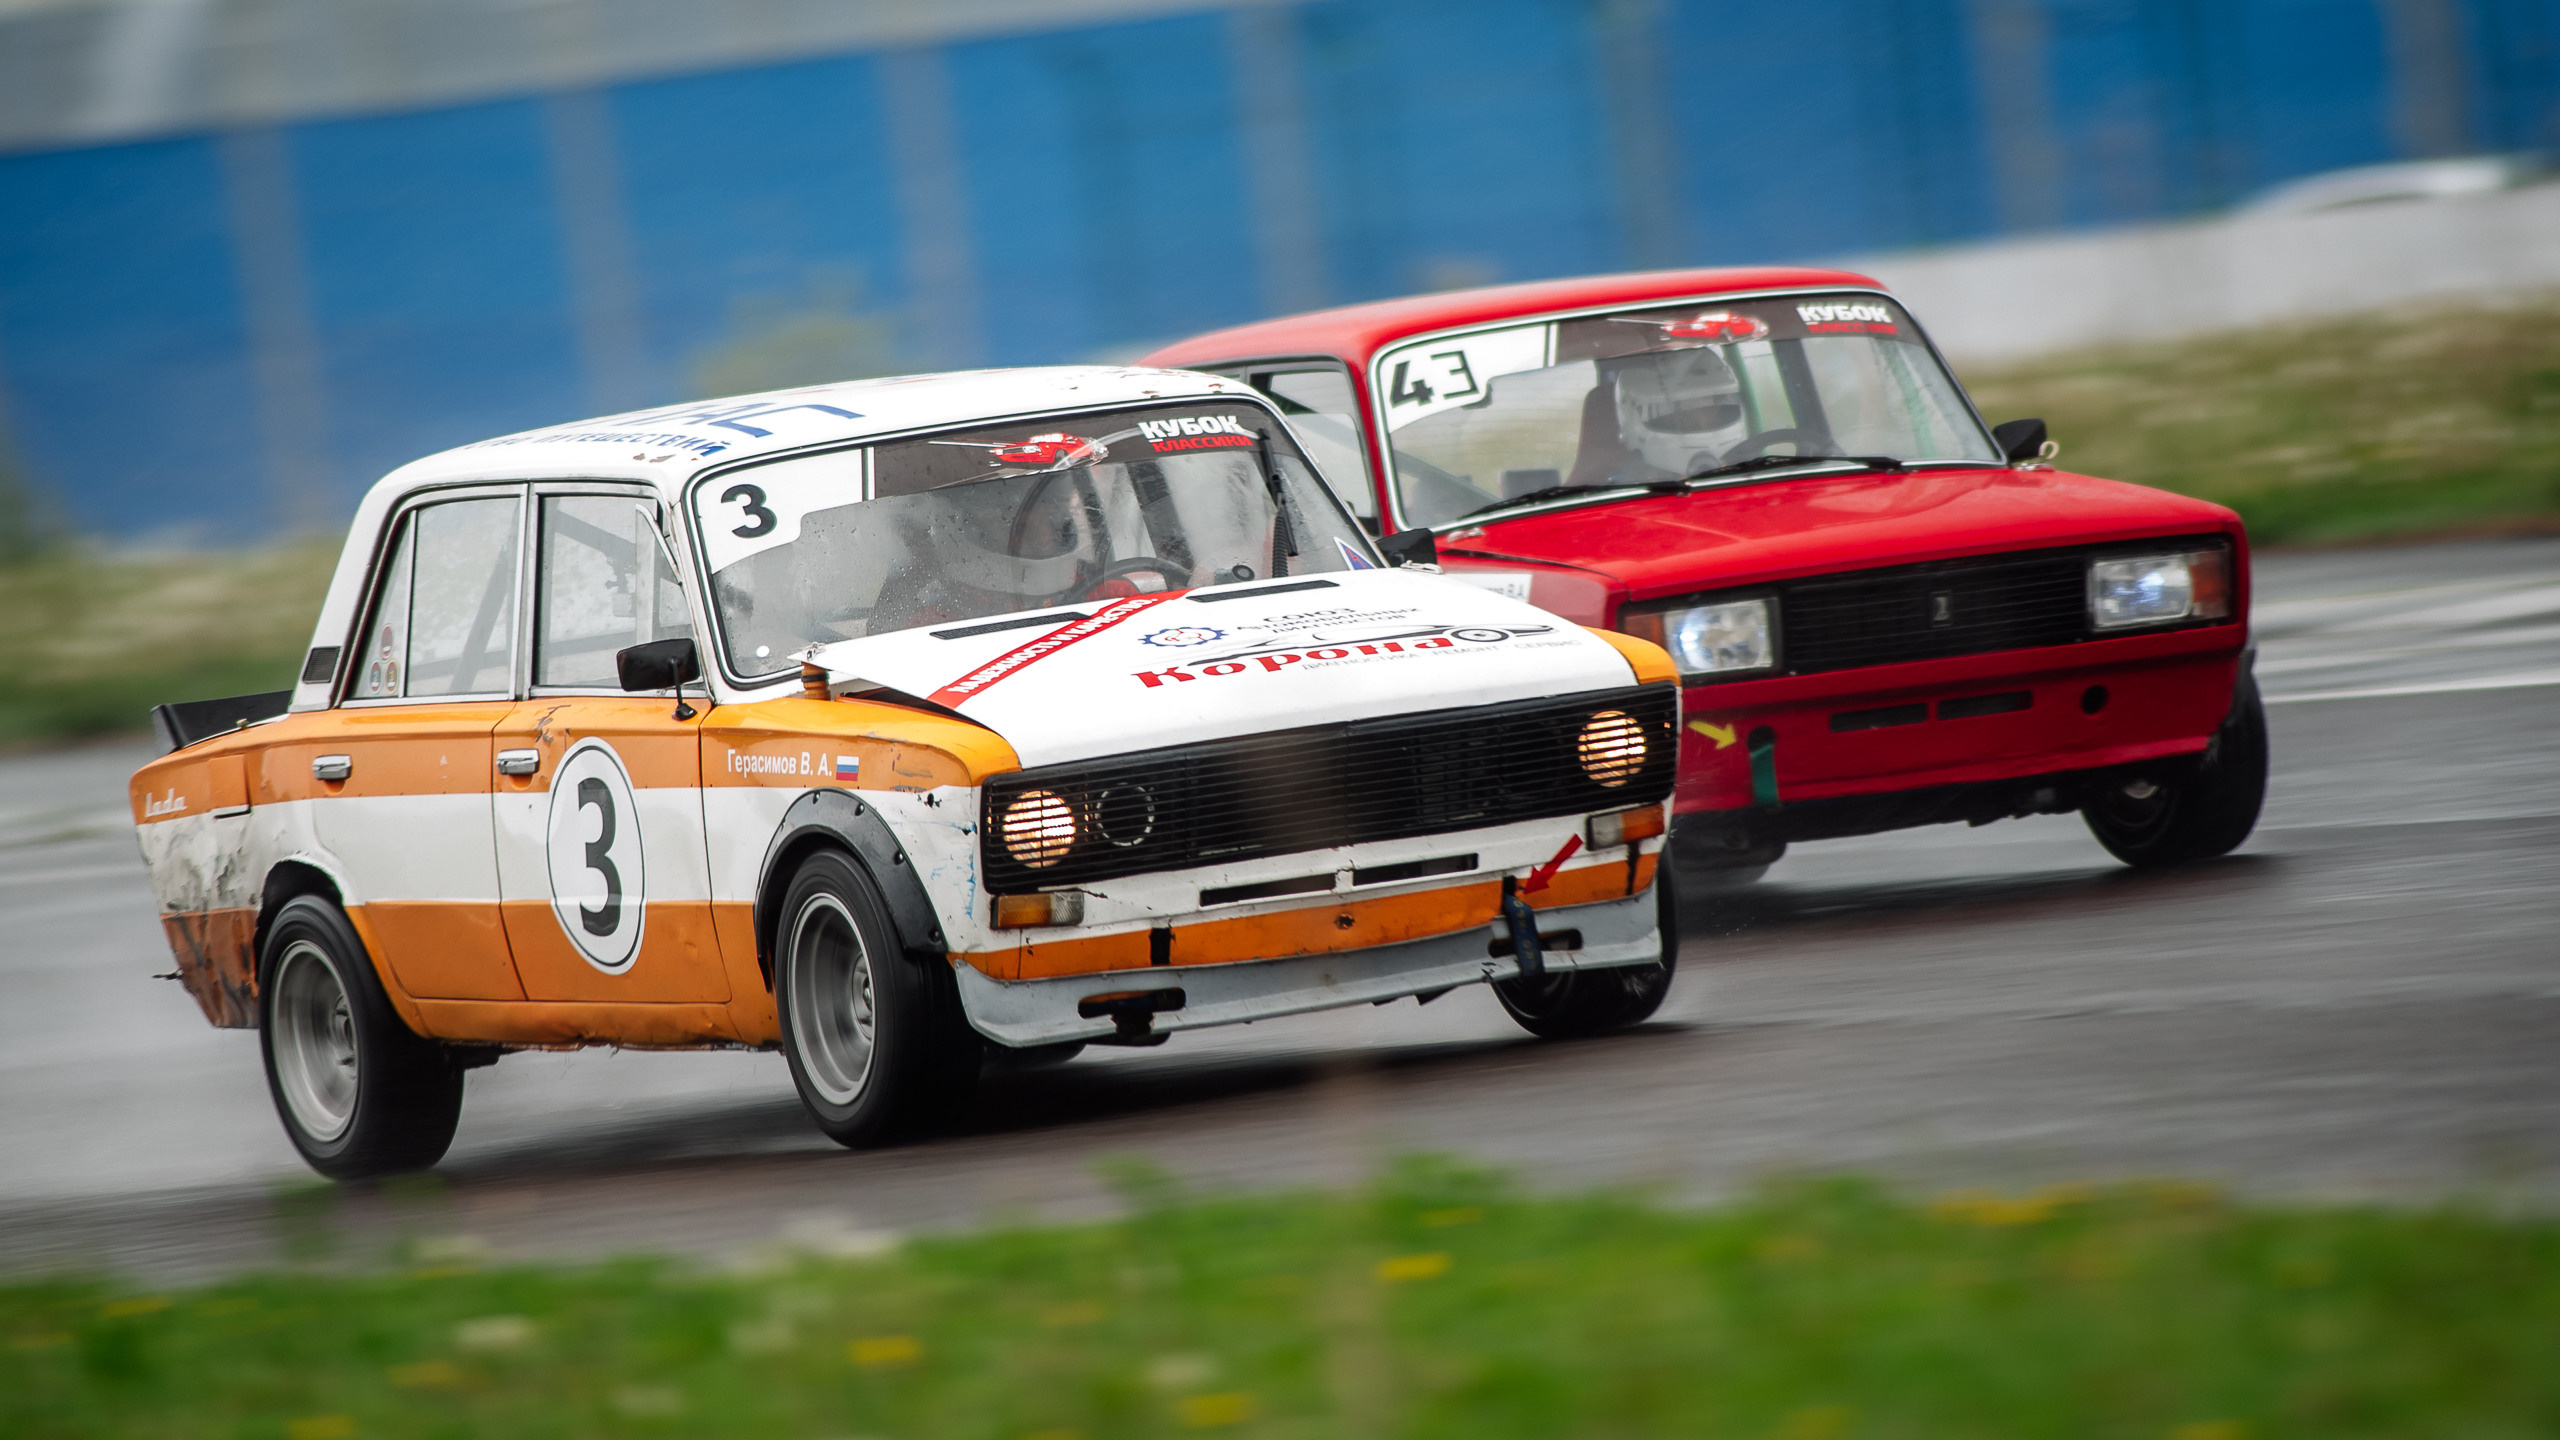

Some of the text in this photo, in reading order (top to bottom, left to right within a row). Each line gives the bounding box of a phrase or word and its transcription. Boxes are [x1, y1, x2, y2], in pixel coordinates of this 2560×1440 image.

[1796, 303, 1893, 323] КУБОК
[1390, 350, 1480, 408] 43
[1138, 415, 1246, 439] КУБОК
[1151, 435, 1252, 452] КЛАССИКИ
[721, 484, 777, 538] 3
[1263, 608, 1356, 622] СОЮЗ
[947, 640, 1063, 693] НАДЕЖНОСТЬ
[727, 749, 832, 778] Герасимов В. А.
[145, 787, 188, 817] Lada
[578, 777, 623, 937] 3
